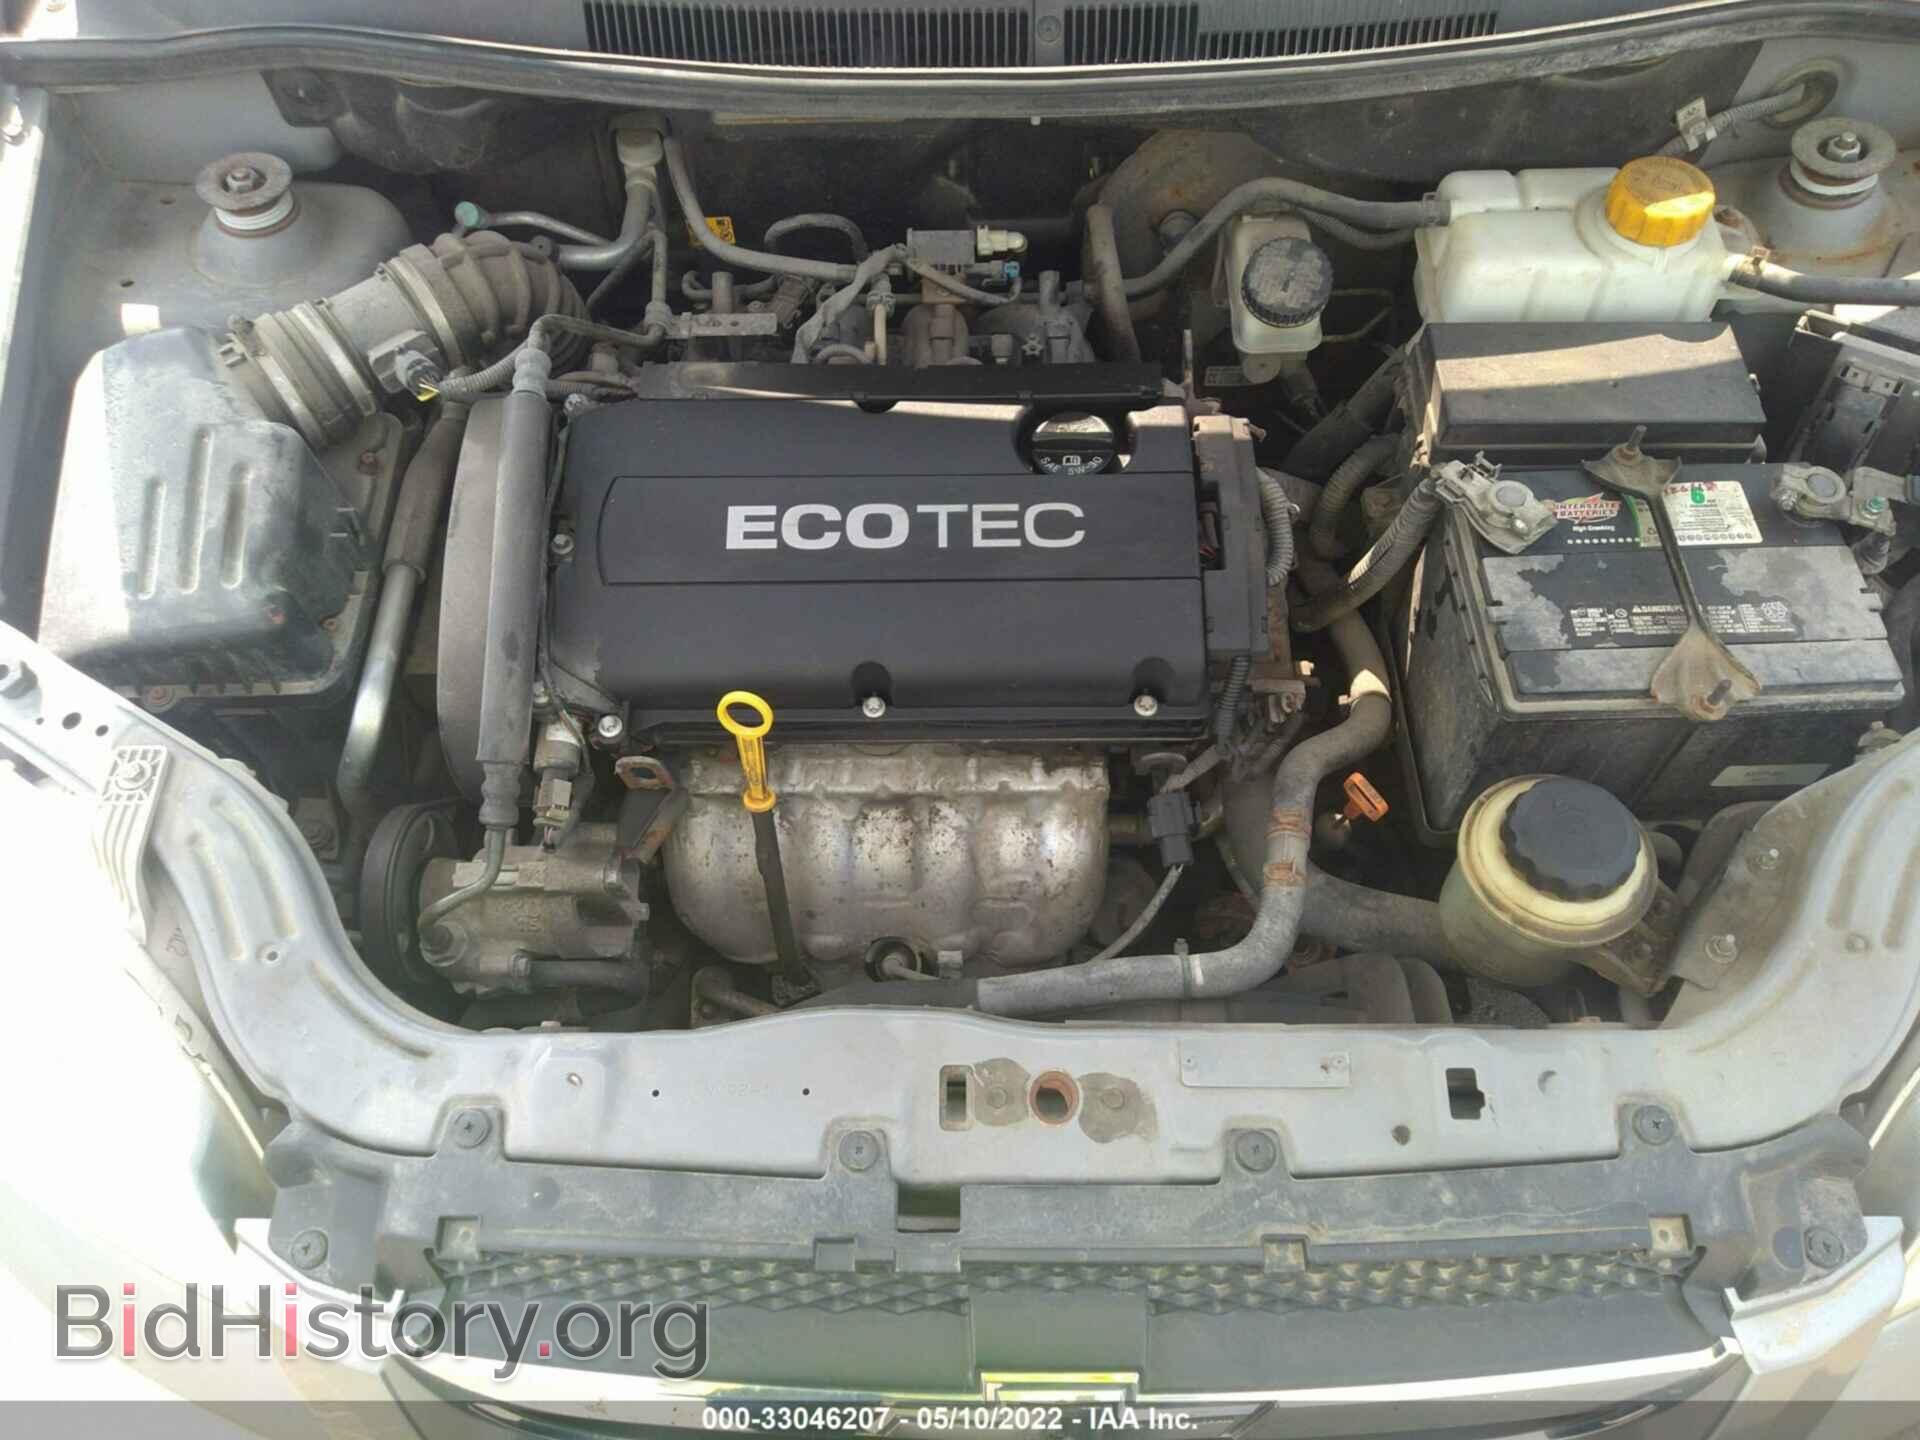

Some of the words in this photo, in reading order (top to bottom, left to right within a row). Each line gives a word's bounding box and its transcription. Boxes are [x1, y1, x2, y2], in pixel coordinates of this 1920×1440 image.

[1040, 456, 1061, 473] SAE
[1067, 456, 1103, 476] 5W-30
[1554, 502, 1618, 510] INTERSTATE
[1558, 509, 1617, 518] BATTERIES
[726, 503, 1086, 550] ECOTEC
